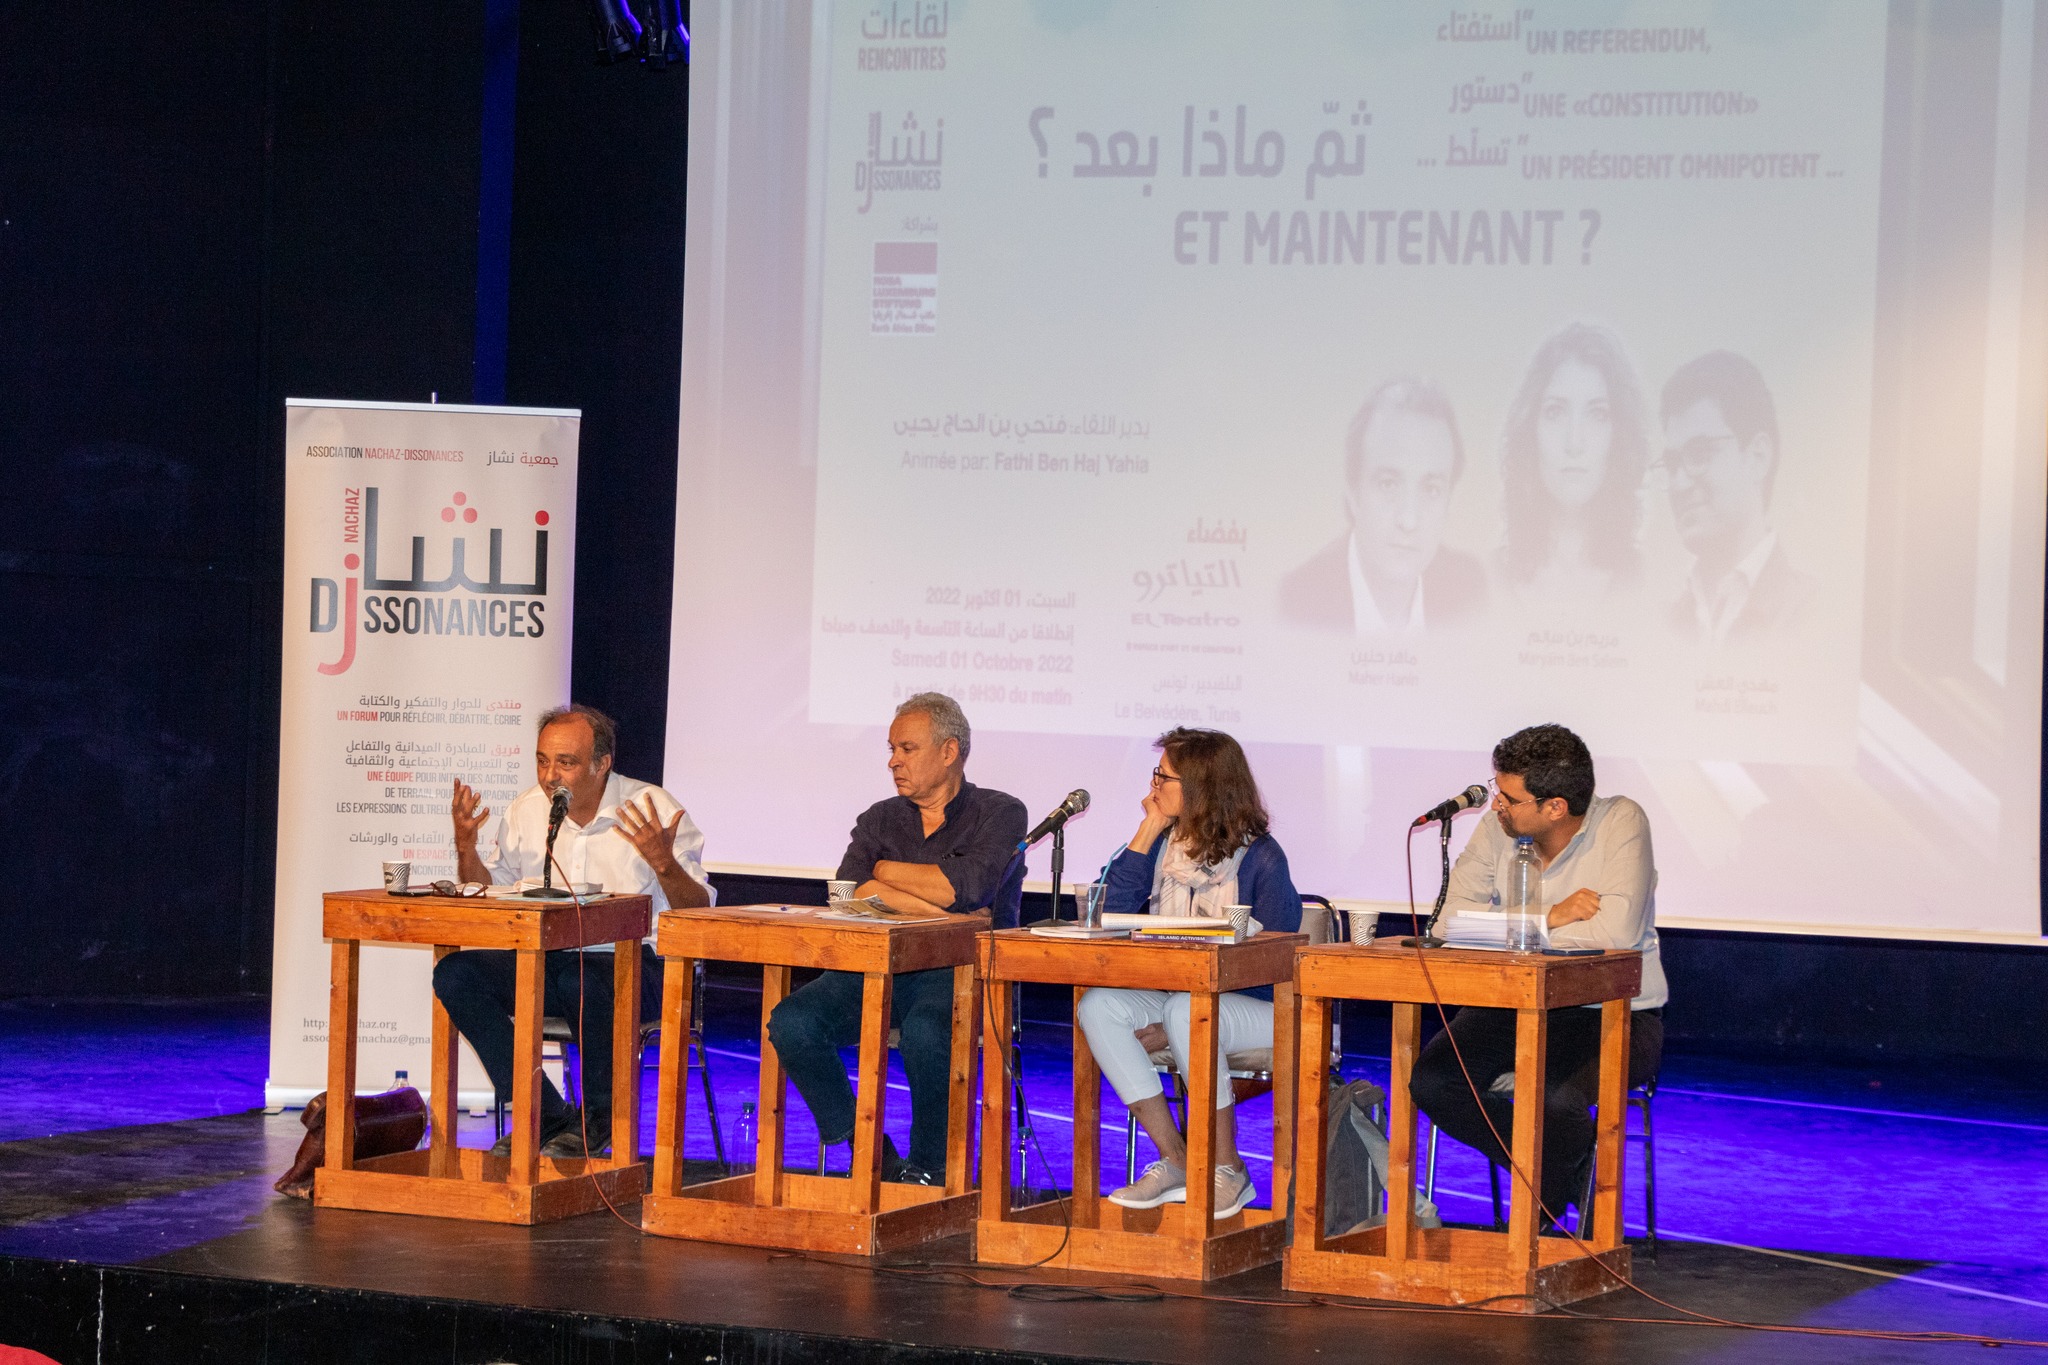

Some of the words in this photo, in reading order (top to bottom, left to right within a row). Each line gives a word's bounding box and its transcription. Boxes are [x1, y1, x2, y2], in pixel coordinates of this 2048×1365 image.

[1526, 30, 1556, 55] UN
[1562, 27, 1712, 55] REFERENDUM,
[857, 46, 946, 72] RENCONTRES
[1523, 92, 1567, 118] UNE
[1573, 90, 1759, 118] «CONSTITUTION»
[1028, 105, 1056, 180] ؟
[1182, 105, 1286, 179] ماذا
[1073, 130, 1159, 197] بعد
[1521, 154, 1552, 180] UN
[1558, 150, 1674, 180] PRÉSIDENT
[1680, 153, 1821, 180] OMNIPOTENT
[1173, 209, 1230, 266] ET
[1243, 209, 1565, 266] MAINTENANT
[1578, 207, 1603, 266] ?
[943, 412, 985, 437] الحاج
[988, 413, 1011, 440] بن
[1014, 413, 1068, 444] فتحي
[306, 445, 363, 459] ASSOCIATION
[364, 447, 464, 462] NACHAZ-DISSONANCES
[486, 450, 514, 466] نشاز
[520, 452, 559, 468] جمعية
[901, 450, 957, 471] Animée
[961, 454, 989, 473] par:
[994, 452, 1033, 471] Fathi
[1037, 453, 1069, 472] Ben
[1073, 454, 1100, 477] Haj
[1104, 454, 1149, 474] Yahia
[344, 487, 360, 543] NACHAZ
[1187, 516, 1247, 552] بفضاء
[1132, 558, 1242, 604] التياترو
[925, 587, 961, 605] 2022
[1004, 589, 1021, 607] 01
[859, 617, 911, 640] والنصف
[914, 618, 961, 638] التاسعة
[964, 620, 1005, 639] الساعة
[1008, 628, 1029, 644] من
[891, 648, 947, 668] Samedi
[950, 650, 968, 669] 01
[973, 652, 1034, 672] Octobre
[1037, 654, 1073, 673] 2022
[1152, 674, 1188, 694] تونس
[359, 695, 400, 709] والكتابة
[404, 695, 448, 710] والتفكير
[947, 683, 966, 700] de
[969, 684, 1006, 704] 9H30
[1009, 686, 1028, 705] du
[1031, 687, 1073, 706] matin
[451, 698, 481, 711] للحوار
[1114, 702, 1130, 718] Le
[1134, 702, 1203, 723] Belvédère,
[1207, 704, 1242, 723] Tunis
[337, 710, 348, 721] UN
[350, 711, 378, 721] FORUM
[379, 711, 401, 723] POUR
[403, 710, 448, 724] RÉFLÉCHIR,
[450, 711, 492, 725] DÉBATTRE,
[494, 713, 522, 726] ÉCRIRE
[346, 740, 391, 754] والتفاعل
[395, 741, 441, 754] الميدانية
[445, 742, 486, 756] للمبادرة
[491, 745, 520, 757] فريق
[345, 754, 394, 769] والثقافية
[456, 757, 501, 770] التعبيرات
[506, 761, 520, 773] مع
[367, 770, 383, 781] UNE
[385, 769, 414, 783] ÉQUIPE
[415, 771, 437, 783] POUR
[467, 773, 483, 785] DES
[484, 773, 518, 785] ACTIONS
[385, 787, 395, 798] DE
[337, 802, 351, 813] LES
[353, 802, 407, 814] EXPRESSIONS
[349, 832, 398, 846] والورشات
[403, 849, 414, 859] UN
[416, 849, 448, 860] ESPACE
